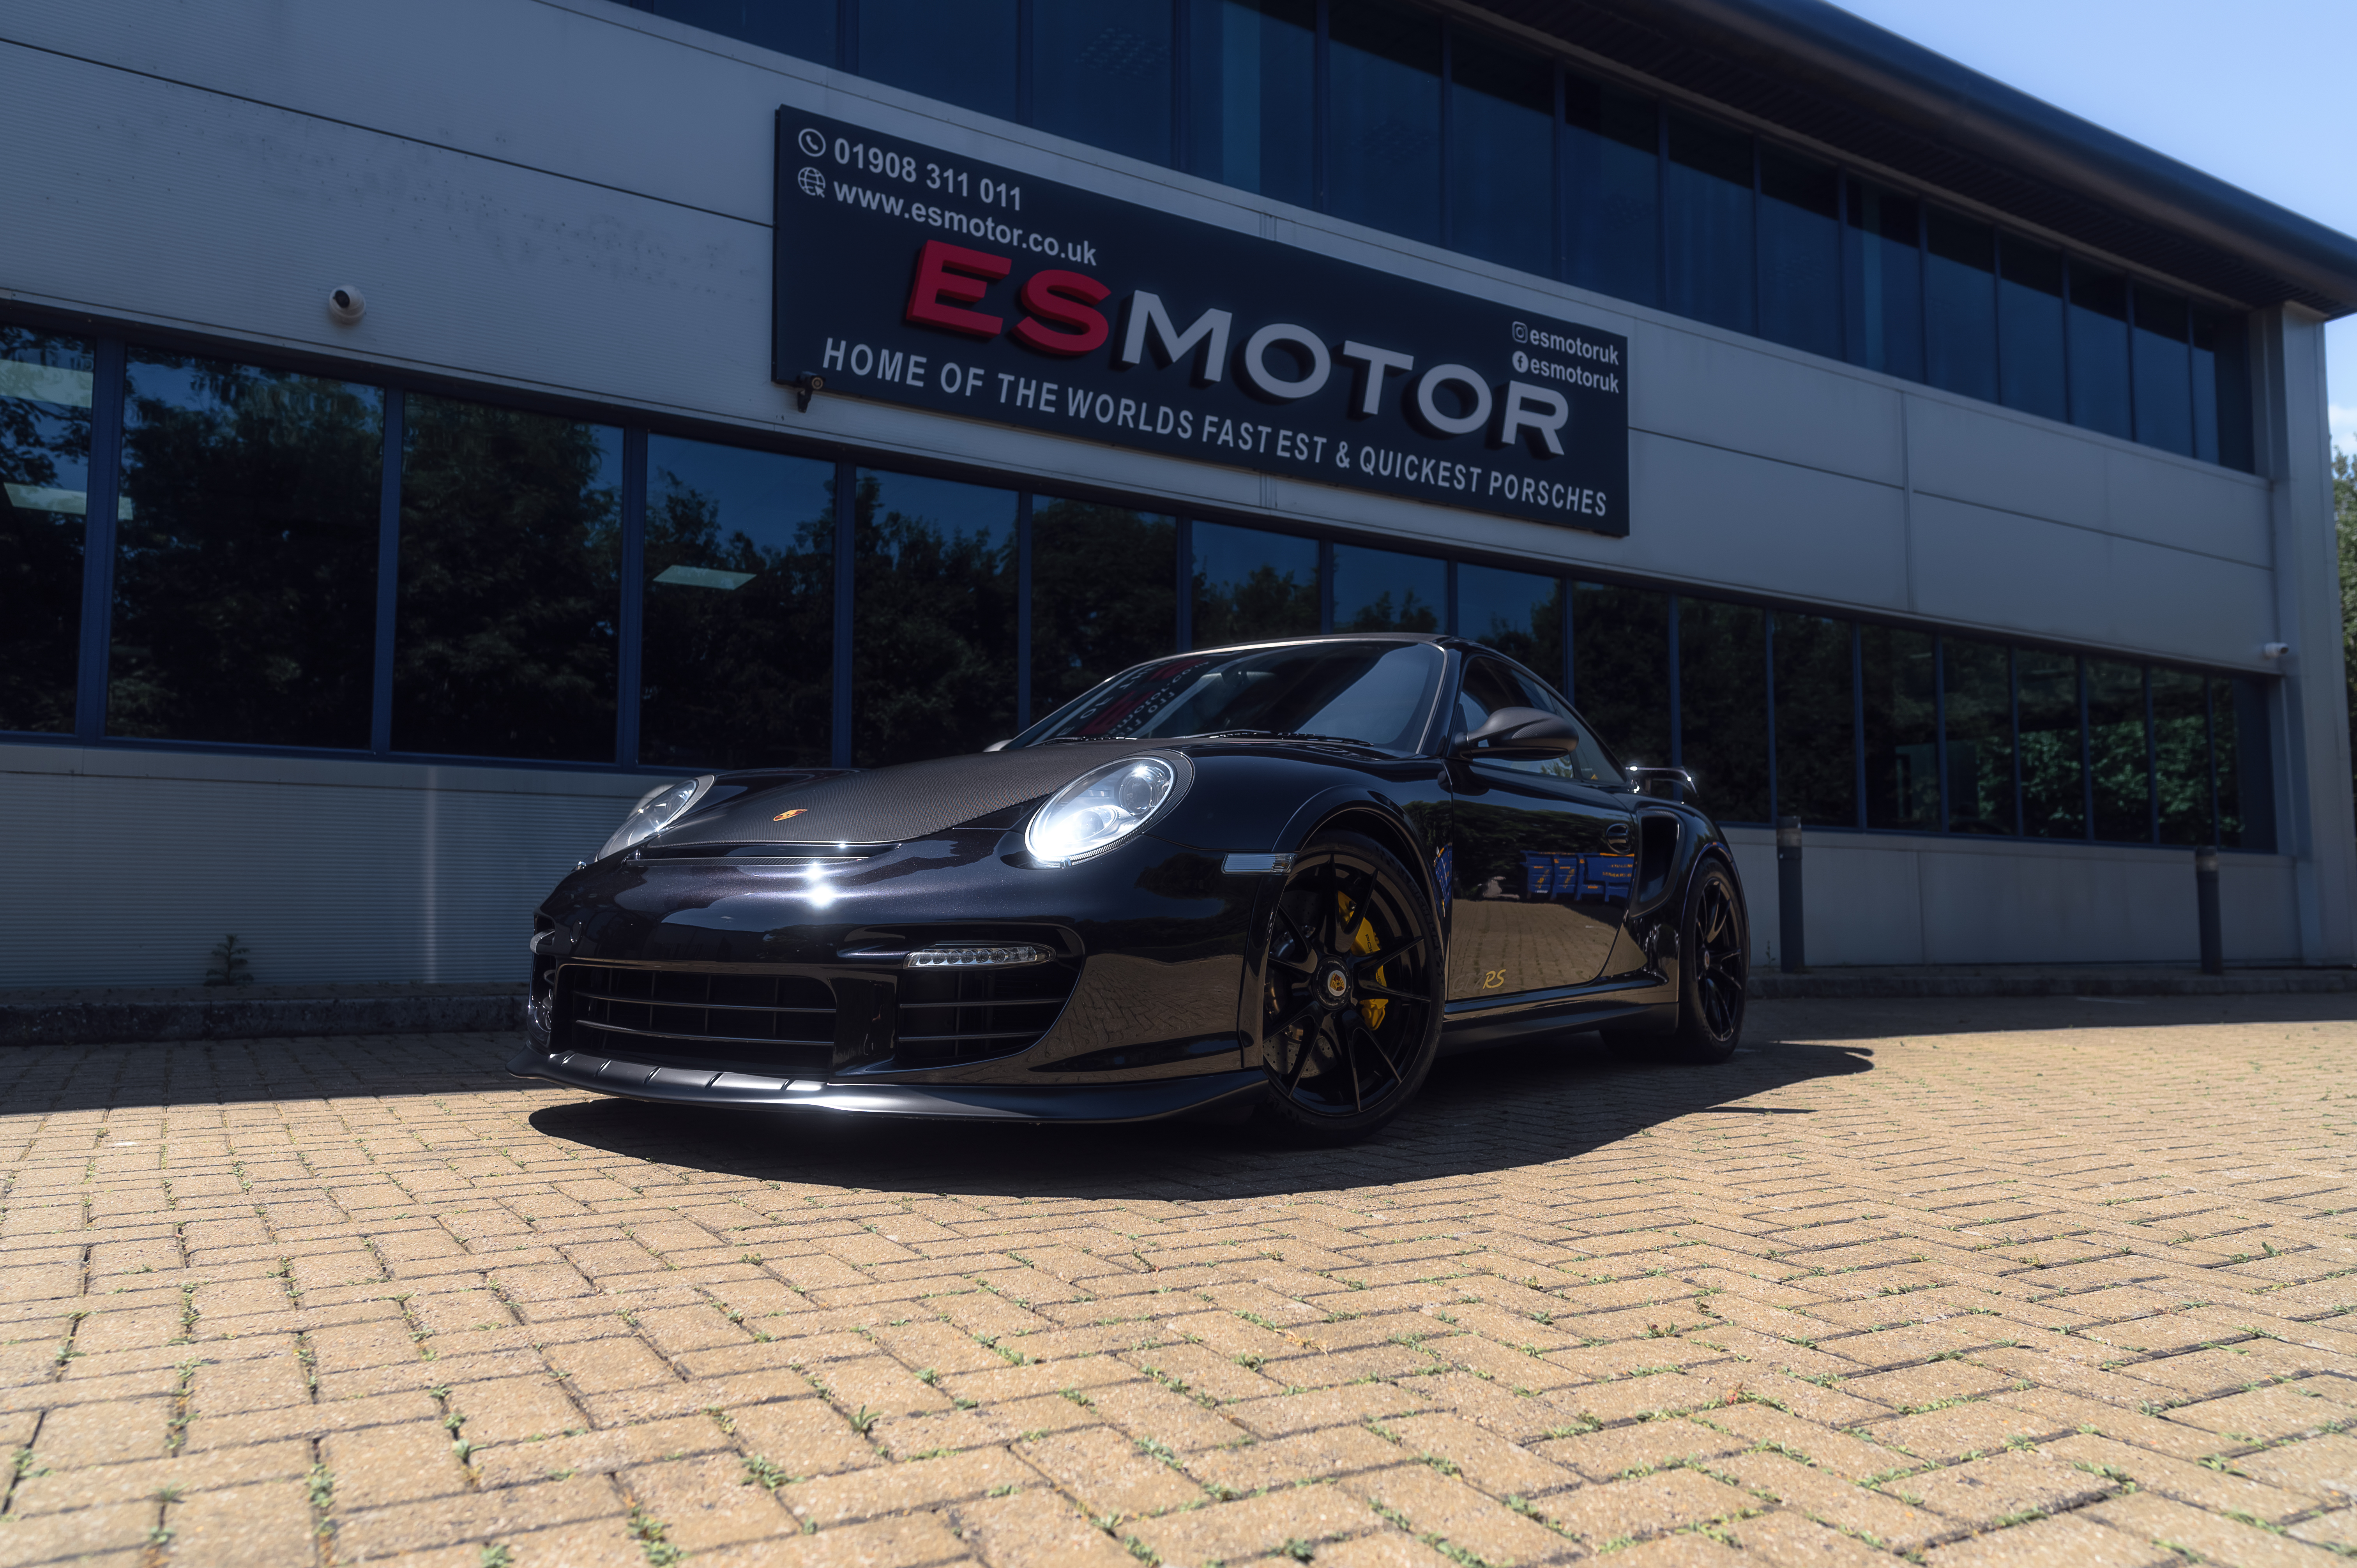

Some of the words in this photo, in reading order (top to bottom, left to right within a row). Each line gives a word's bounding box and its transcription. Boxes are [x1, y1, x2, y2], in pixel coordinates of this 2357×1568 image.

[834, 138, 917, 182] 01908
[926, 163, 968, 197] 311
[980, 178, 1020, 211] 011
[833, 181, 1097, 266] www.esmotor.co.uk
[1530, 329, 1619, 365] esmotoruk
[1530, 358, 1619, 394] esmotoruk
[823, 337, 927, 387] HOME
[940, 362, 984, 396] OF
[998, 373, 1058, 413] THE
[1068, 387, 1193, 439] WORLDS
[1202, 415, 1327, 463] FASTEST
[1336, 441, 1350, 468] &
[1360, 446, 1482, 492] QUICKEST
[1489, 471, 1606, 516] PORSCHES
[1407, 881, 1440, 949] MICHELIN
[1482, 969, 1506, 989] RS
